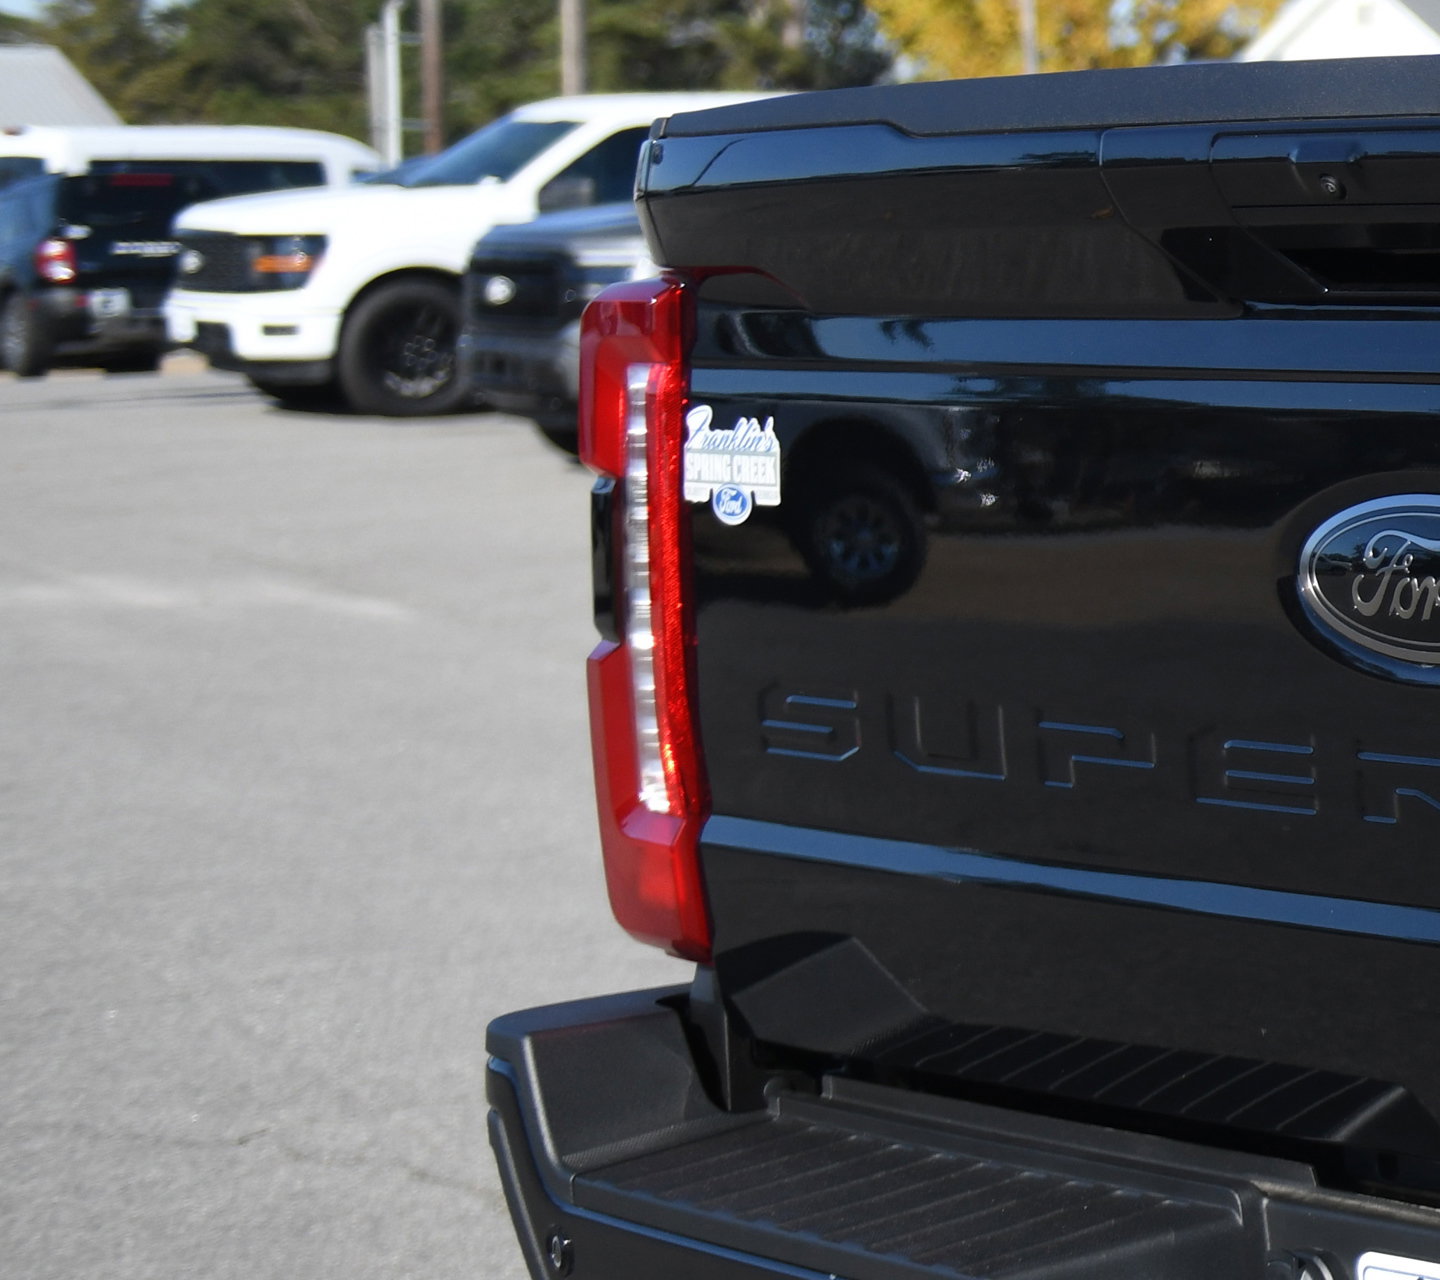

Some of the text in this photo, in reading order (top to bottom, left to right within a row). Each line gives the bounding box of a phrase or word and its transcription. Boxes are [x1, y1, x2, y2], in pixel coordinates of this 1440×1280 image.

[686, 408, 774, 453] Franklin's
[687, 452, 776, 485] SPRING CREEK
[719, 487, 744, 516] Ford
